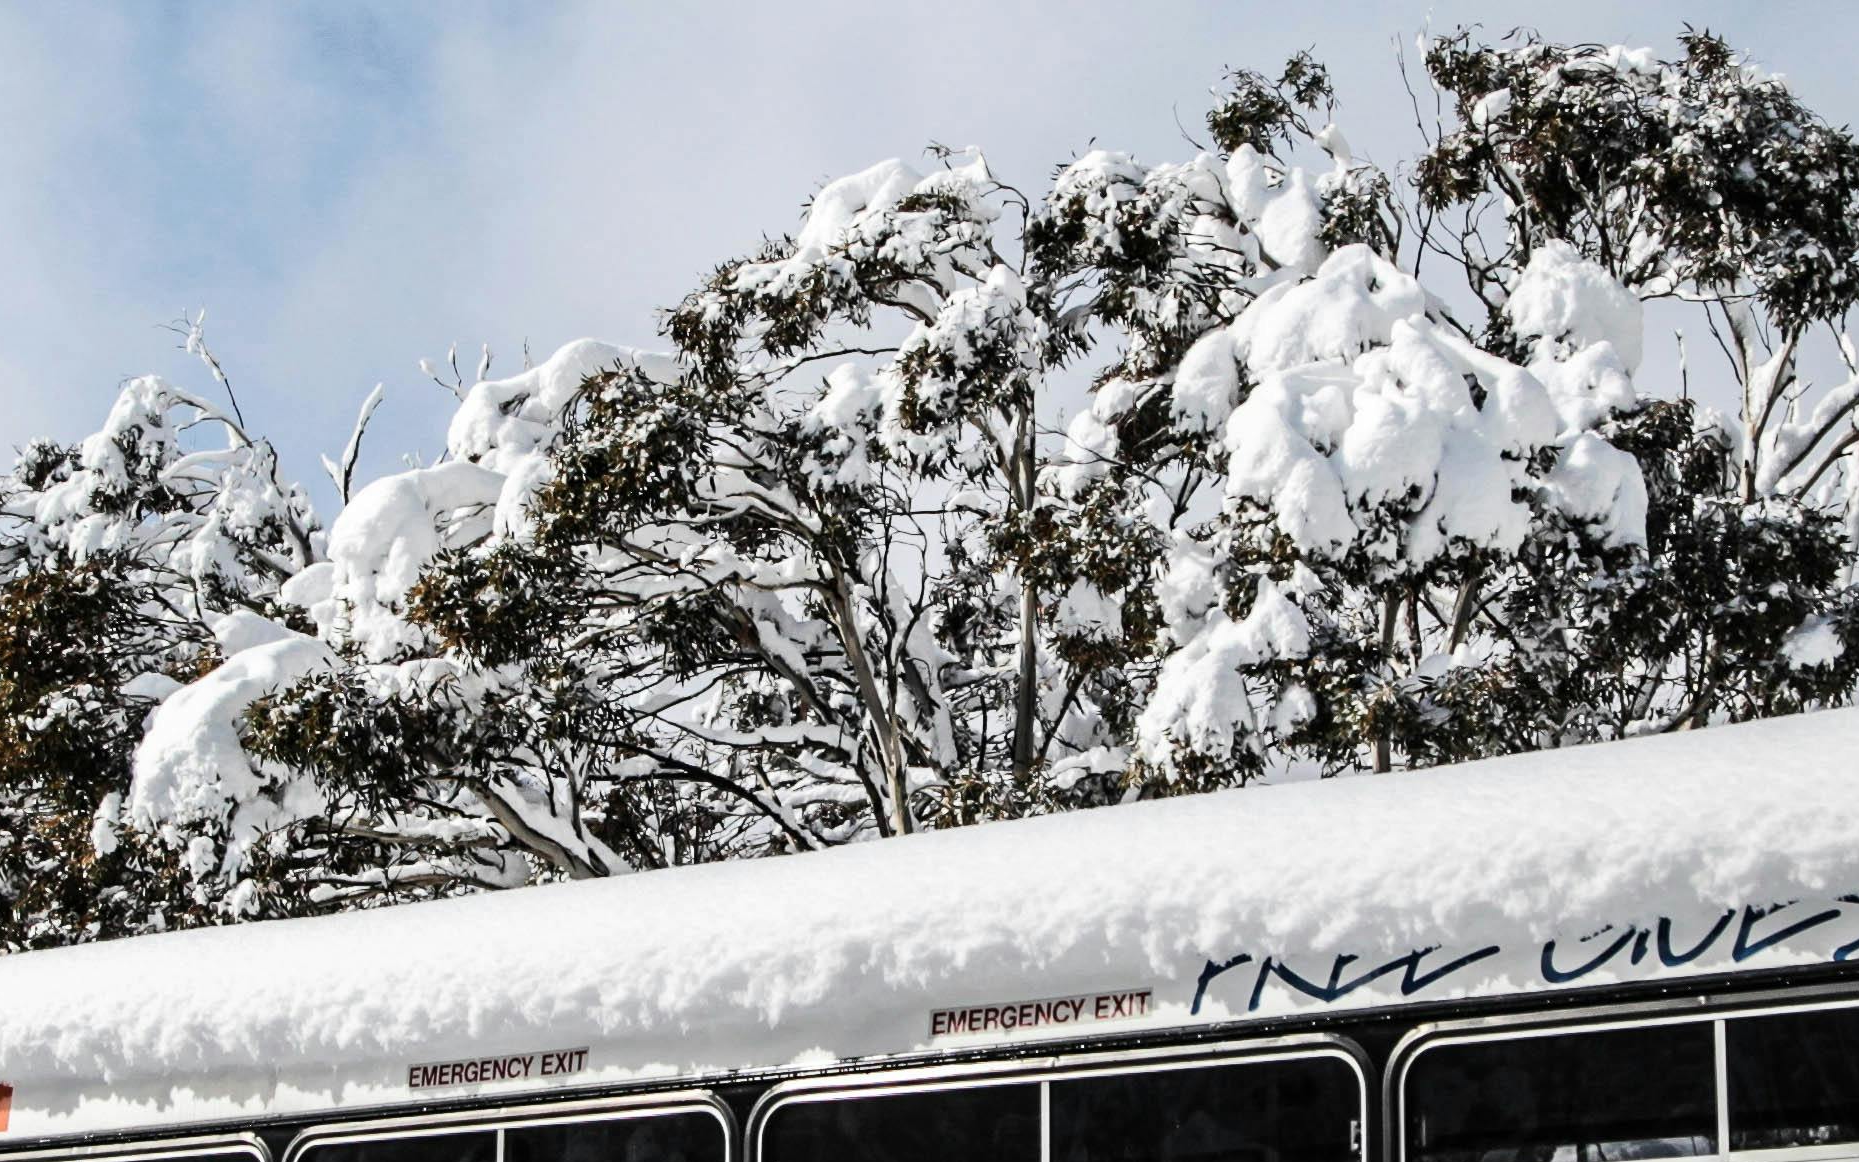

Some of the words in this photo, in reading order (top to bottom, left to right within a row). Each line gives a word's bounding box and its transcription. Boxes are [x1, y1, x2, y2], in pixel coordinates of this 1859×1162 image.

[931, 998, 1086, 1036] EMERGENCY
[1094, 991, 1152, 1020] EXIT
[408, 1055, 535, 1088] EMERGENCY
[540, 1050, 588, 1076] EXIT
